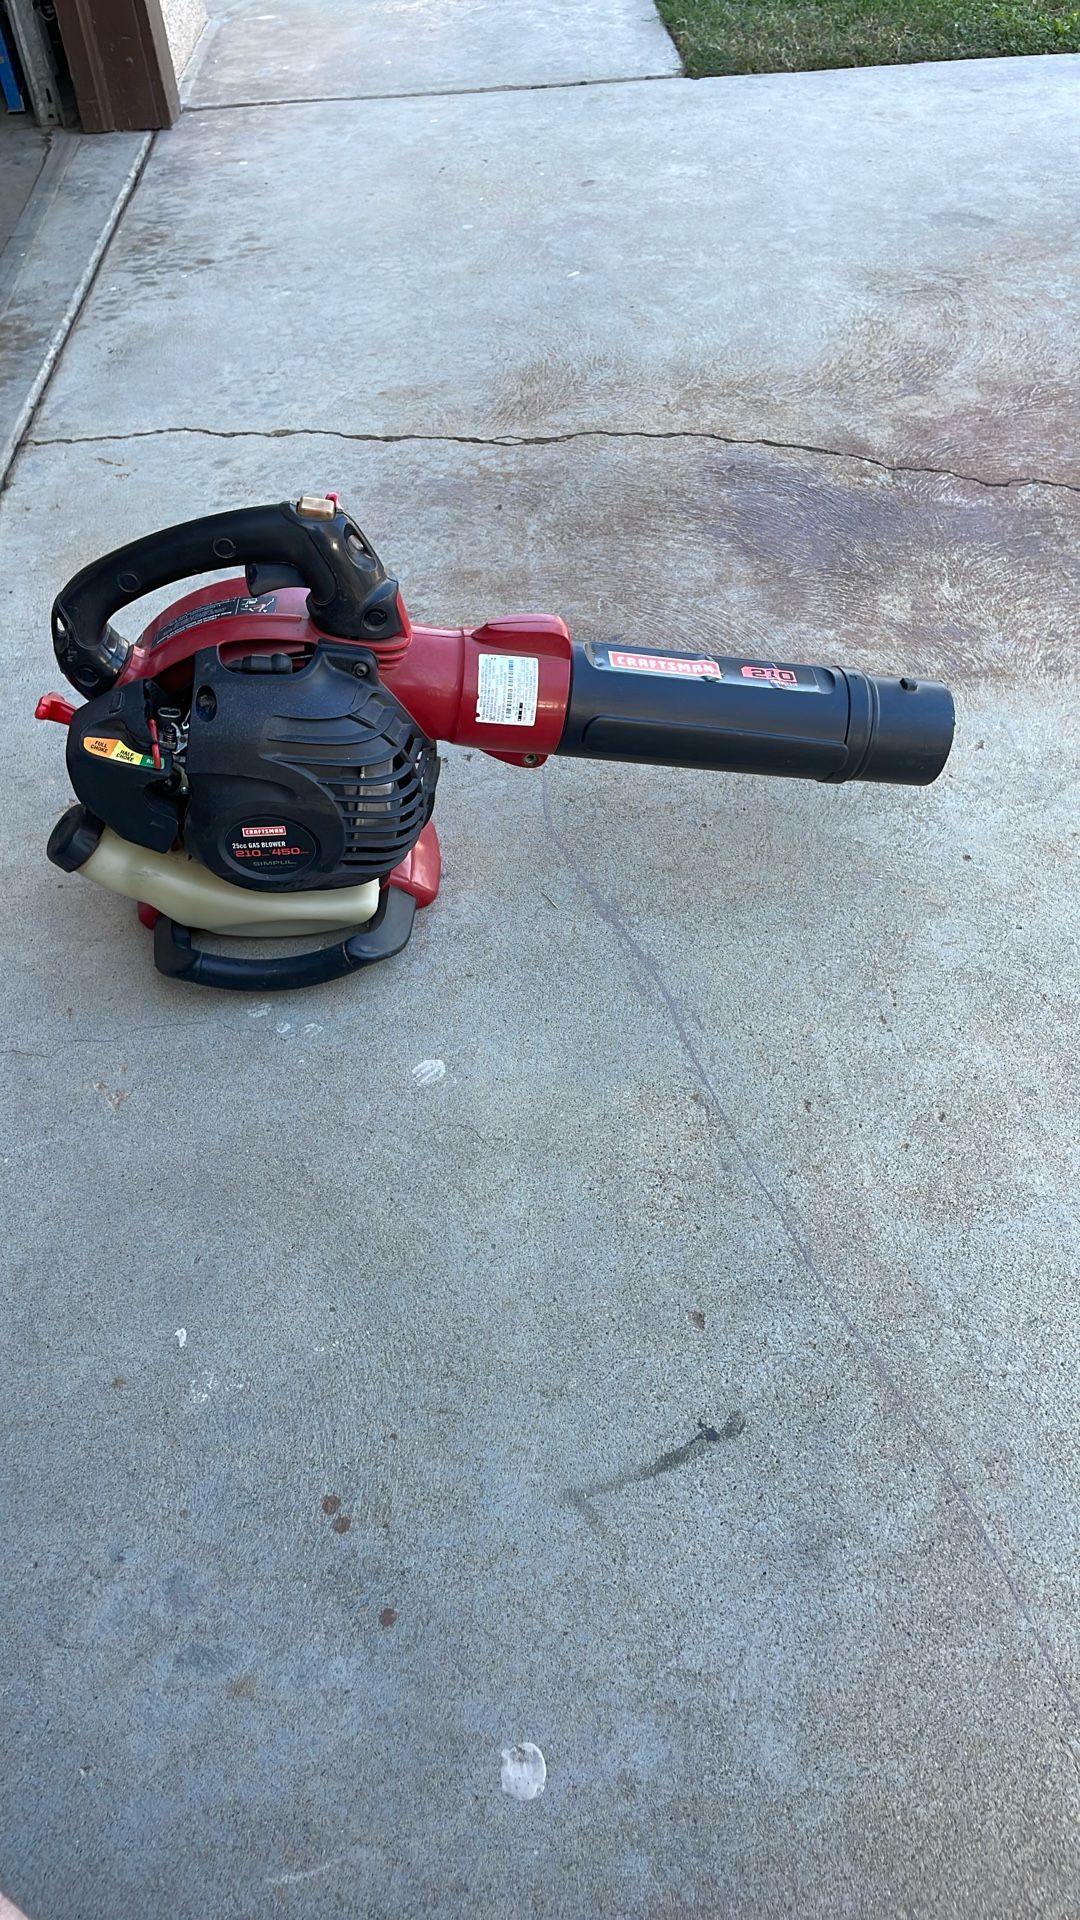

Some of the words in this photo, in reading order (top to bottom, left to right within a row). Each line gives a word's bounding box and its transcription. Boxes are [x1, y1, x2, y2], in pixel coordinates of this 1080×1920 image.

[617, 656, 715, 674] CRAFTSMAN
[750, 668, 794, 681] 210
[91, 744, 108, 753] CHOKE
[95, 741, 107, 749] FULL
[116, 754, 135, 762] CHOKE
[235, 849, 261, 857] 210
